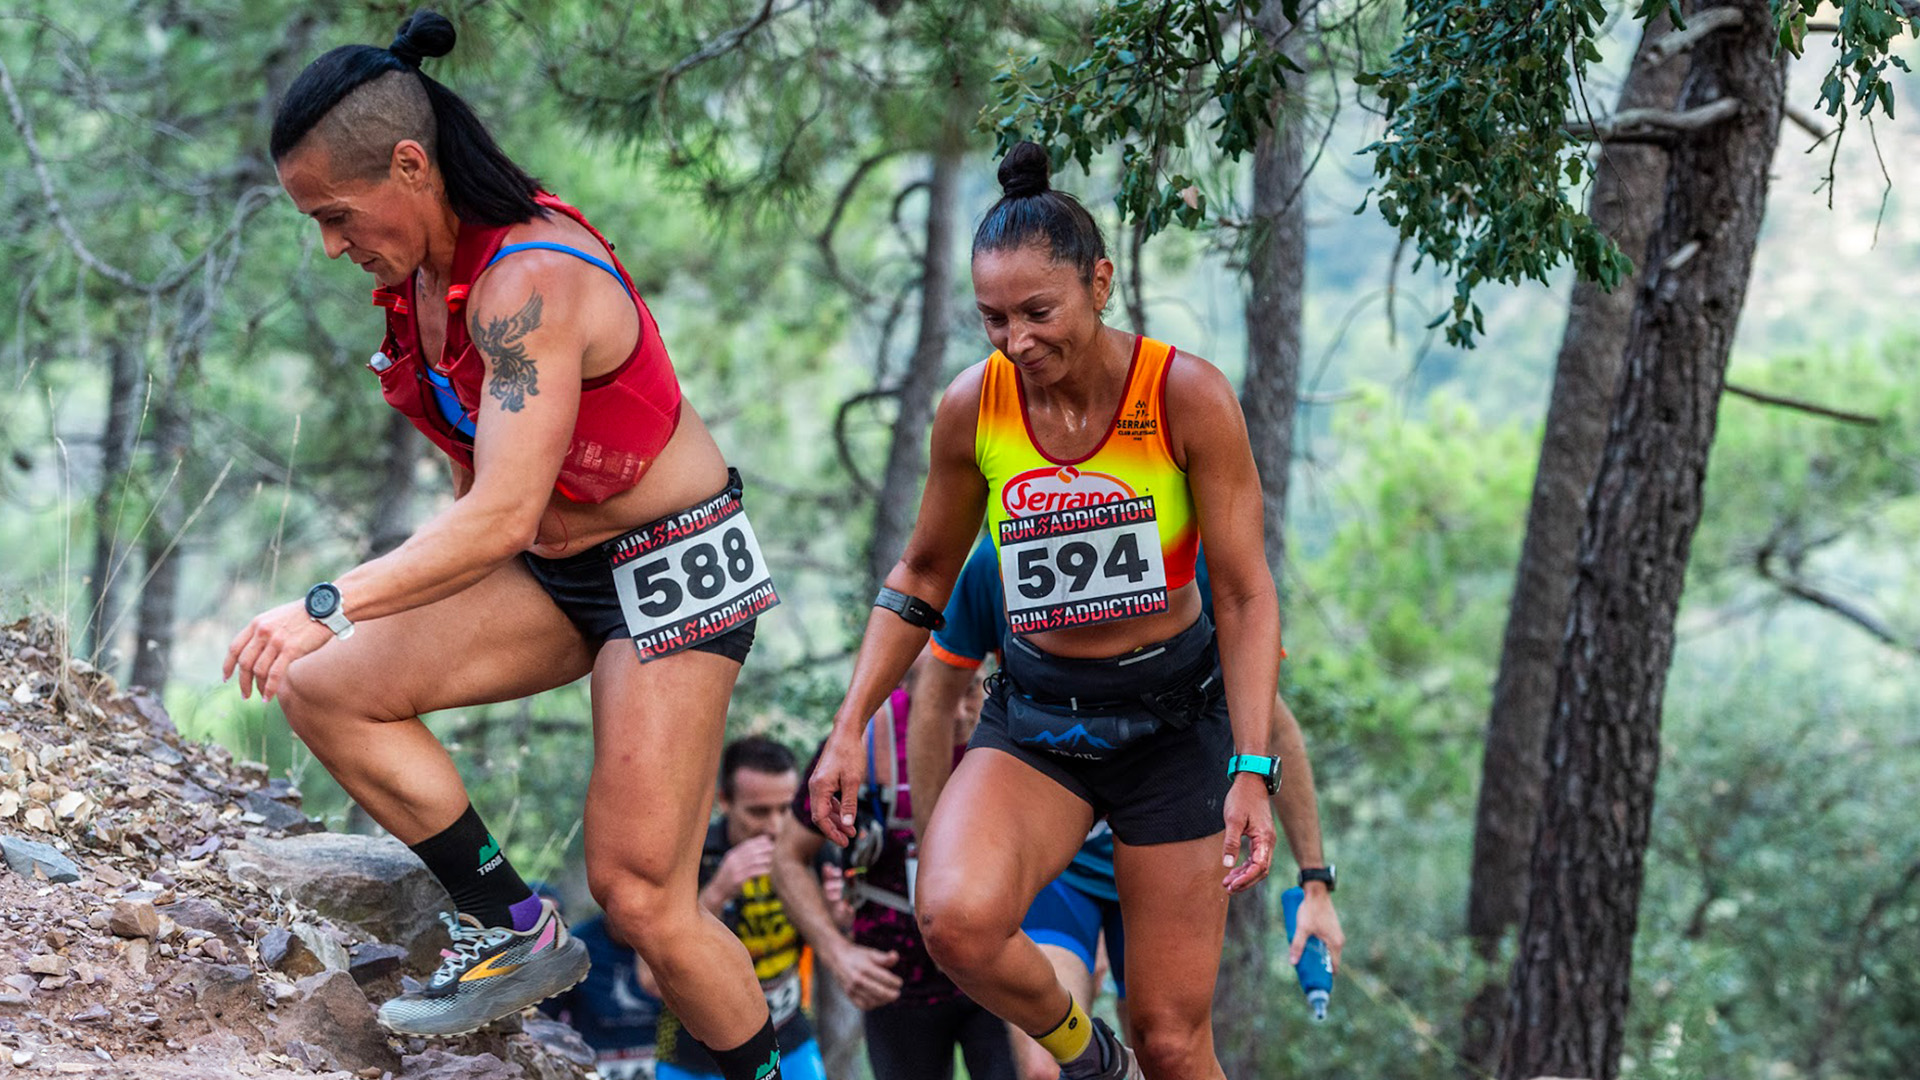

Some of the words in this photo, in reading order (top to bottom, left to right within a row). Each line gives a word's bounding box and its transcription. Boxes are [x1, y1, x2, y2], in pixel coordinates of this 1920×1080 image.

[1116, 419, 1157, 429] SERRANO
[1001, 518, 1036, 542] RUN
[1050, 499, 1154, 534] ADDICTION
[633, 527, 754, 618] 588
[1017, 533, 1149, 599] 594
[636, 626, 684, 659] RUN
[700, 583, 777, 638] ADDICTION
[1010, 610, 1049, 633] RUN
[1064, 590, 1166, 625] ADDICTION
